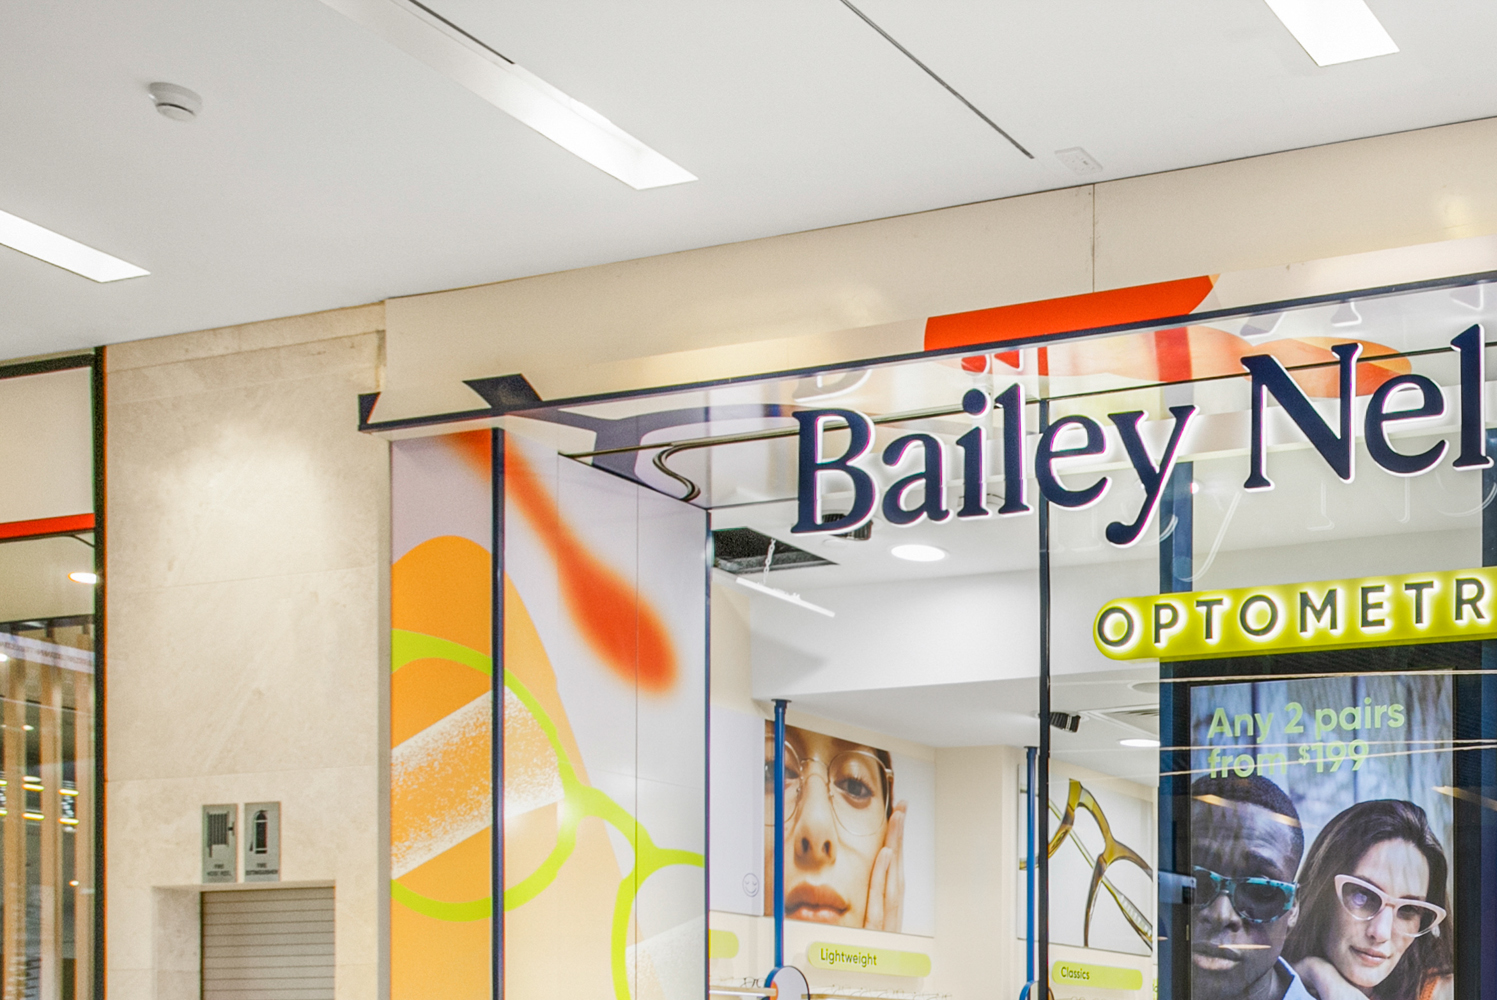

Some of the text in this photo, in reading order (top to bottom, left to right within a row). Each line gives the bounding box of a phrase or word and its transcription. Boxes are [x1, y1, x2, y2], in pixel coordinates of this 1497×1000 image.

[791, 382, 1199, 548] Bailey
[1207, 696, 1405, 744] Any 2 pairs
[1207, 738, 1370, 779] from $199
[820, 947, 877, 968] Lightweight
[1060, 966, 1091, 980] Classics
